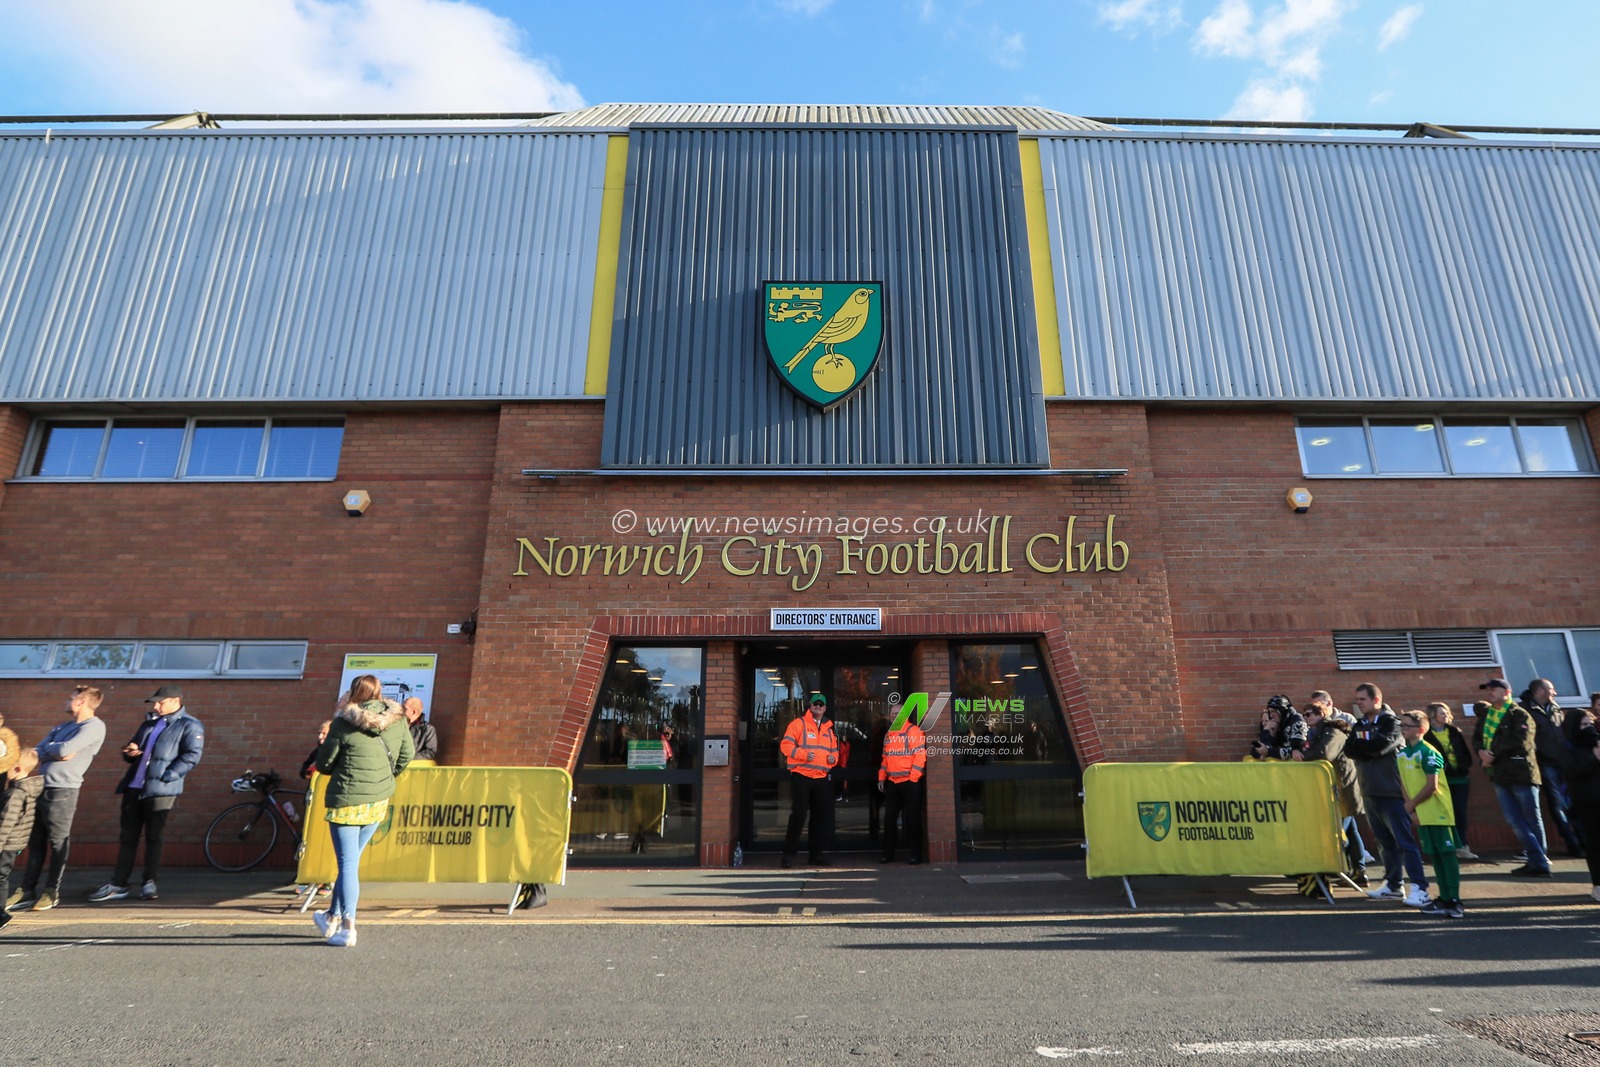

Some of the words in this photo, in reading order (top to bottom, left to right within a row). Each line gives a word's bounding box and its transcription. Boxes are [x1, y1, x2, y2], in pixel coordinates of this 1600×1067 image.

[512, 517, 704, 585] Norwich
[721, 527, 823, 592] City
[836, 515, 1013, 575] Football
[1025, 514, 1130, 574] Club
[829, 613, 877, 625] ENTRANCE
[398, 804, 474, 828] NORWICH
[477, 804, 515, 828] CITY
[1175, 800, 1251, 823] NORWICH
[1253, 800, 1288, 823] CITY
[396, 831, 444, 846] FOOTBALL
[446, 831, 472, 845] CLUB
[1178, 827, 1227, 841] FOOTBALL
[1228, 827, 1255, 841] CLUB
